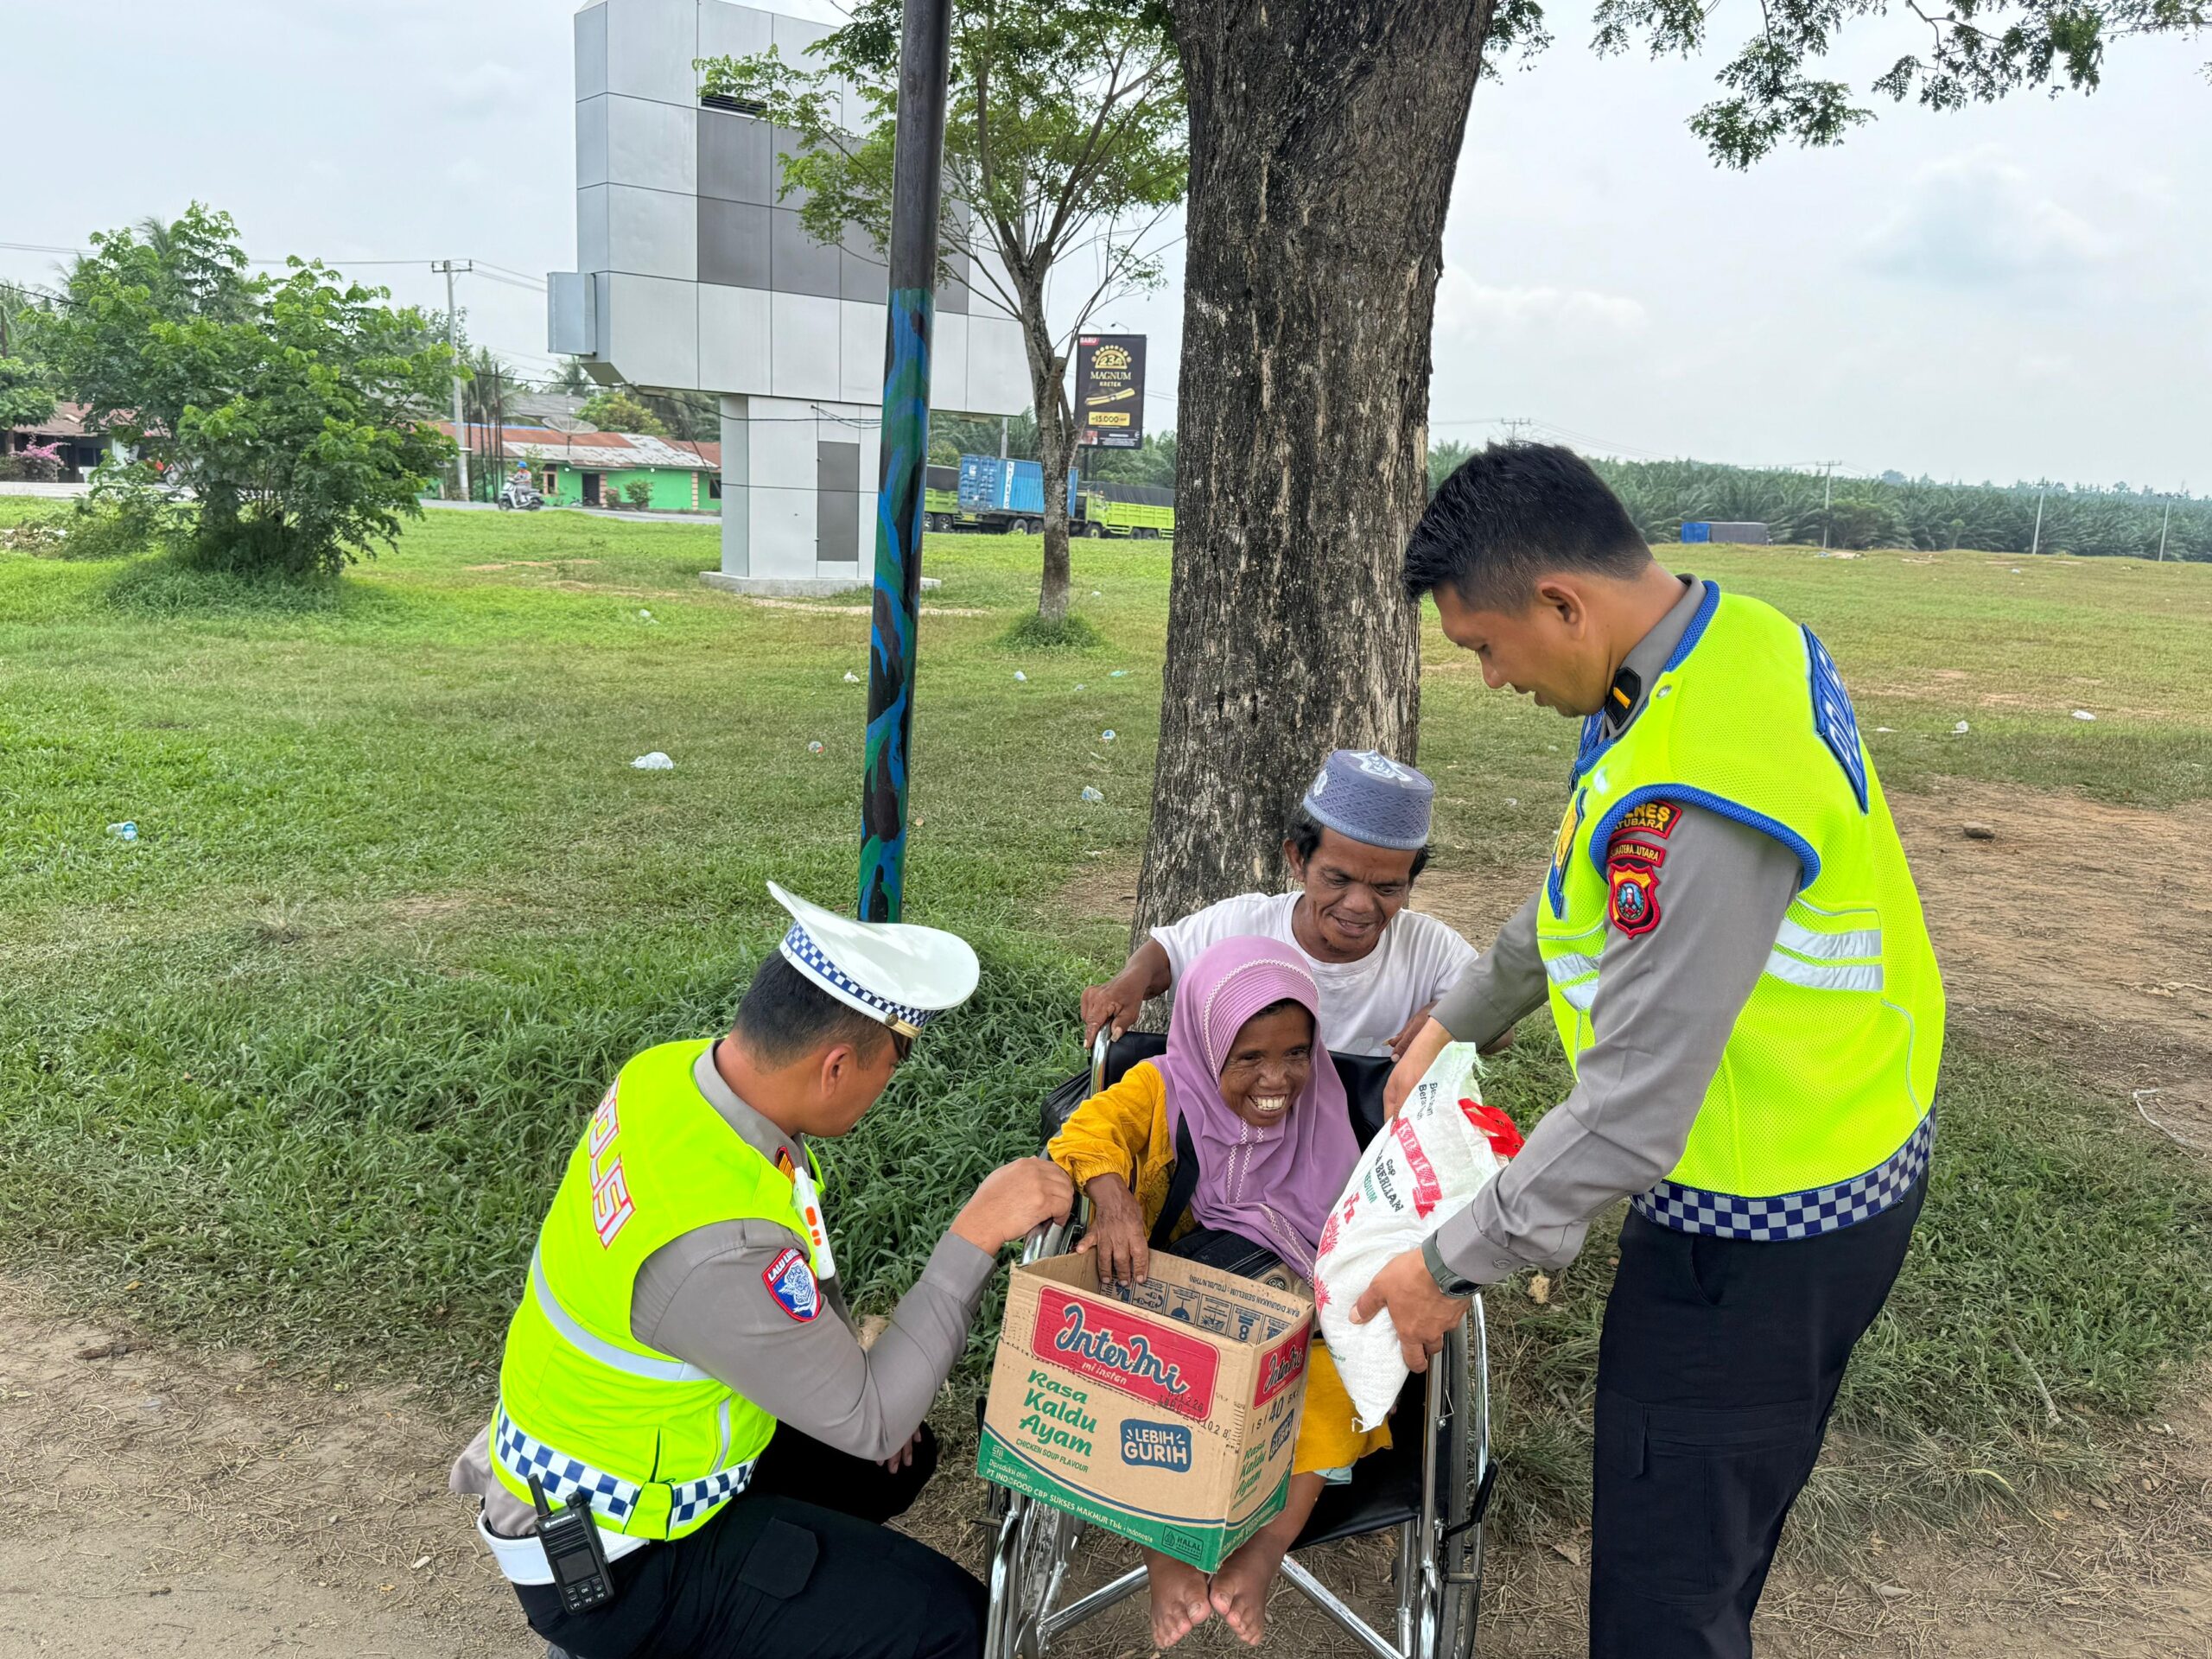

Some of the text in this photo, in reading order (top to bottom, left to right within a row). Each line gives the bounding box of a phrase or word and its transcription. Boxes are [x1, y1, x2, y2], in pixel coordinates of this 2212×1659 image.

[1099, 355, 1122, 365] 234
[1090, 371, 1131, 380] MAGNUM
[1615, 817, 1663, 831] TUBARA
[1637, 846, 1659, 861] UTARA
[1376, 1162, 1404, 1212] BERLIAN
[767, 1258, 786, 1282] LALU
[1230, 1287, 1255, 1301] SEBELUM
[1256, 1298, 1286, 1313] DIGUNAKAN
[1239, 1325, 1249, 1340] 8
[1055, 1303, 1191, 1395] InterMi
[1082, 1362, 1128, 1385] mi instan
[1027, 1369, 1088, 1405] Rasa
[1023, 1388, 1097, 1433] Kaldu
[1269, 1396, 1284, 1423] 40
[1018, 1414, 1092, 1457] Ayam
[1135, 1428, 1173, 1445] LEBIH
[1015, 1438, 1089, 1473] CHICKEN SOUP FLAVOUR
[1124, 1441, 1187, 1465] GURIH
[988, 1459, 1015, 1475] Diproduksi
[1016, 1471, 1027, 1480] oleh
[1033, 1489, 1048, 1498] CBP
[1050, 1495, 1075, 1510] SUKSES
[1077, 1505, 1108, 1523] MAKMUR
[1109, 1520, 1122, 1529] Tbk
[1177, 1536, 1201, 1551] HALAL
